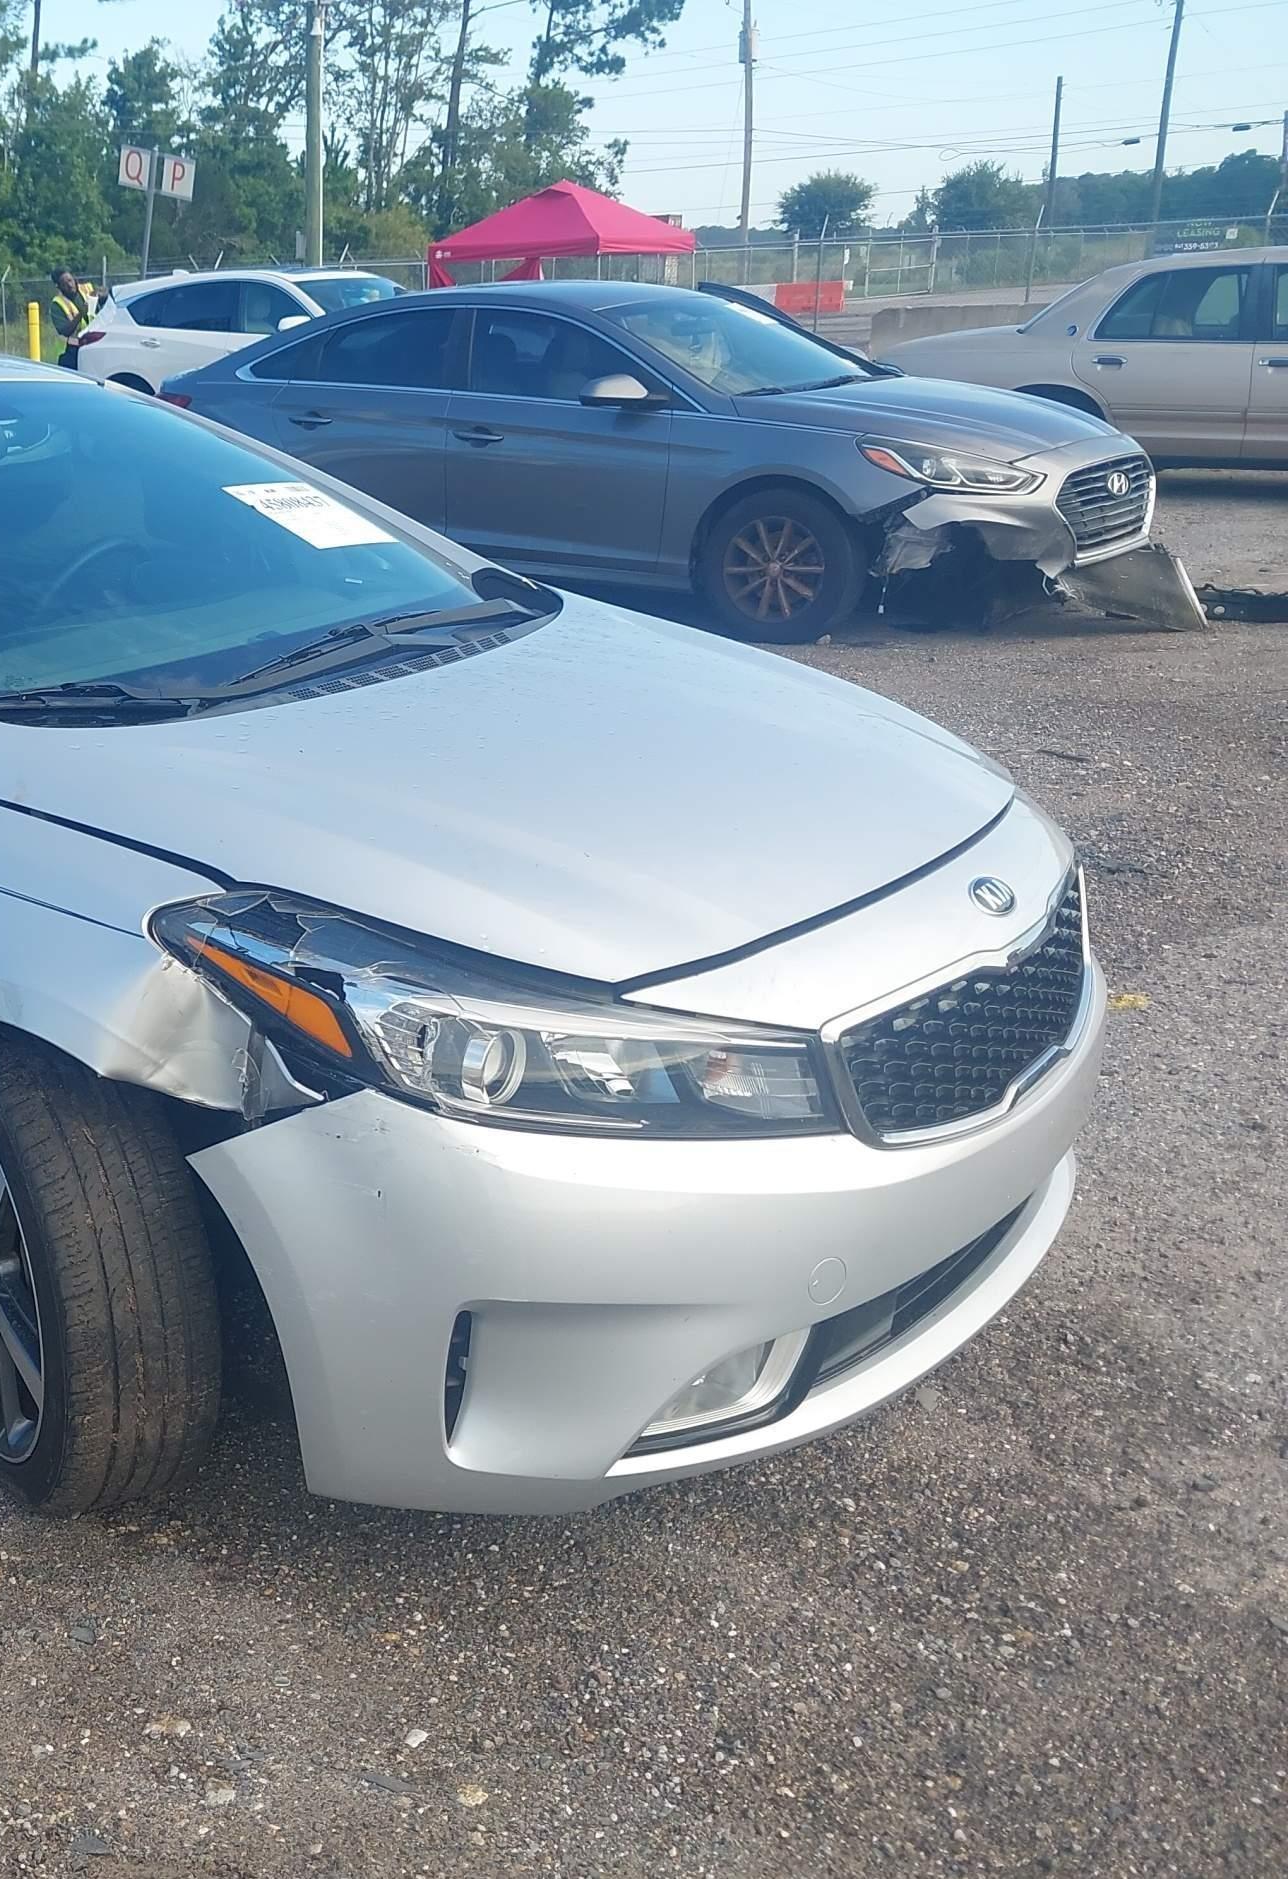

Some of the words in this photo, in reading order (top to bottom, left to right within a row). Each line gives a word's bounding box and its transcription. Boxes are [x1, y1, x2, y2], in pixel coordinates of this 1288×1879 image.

[125, 150, 143, 186] Q
[171, 160, 186, 192] P
[1176, 227, 1221, 238] LEASING
